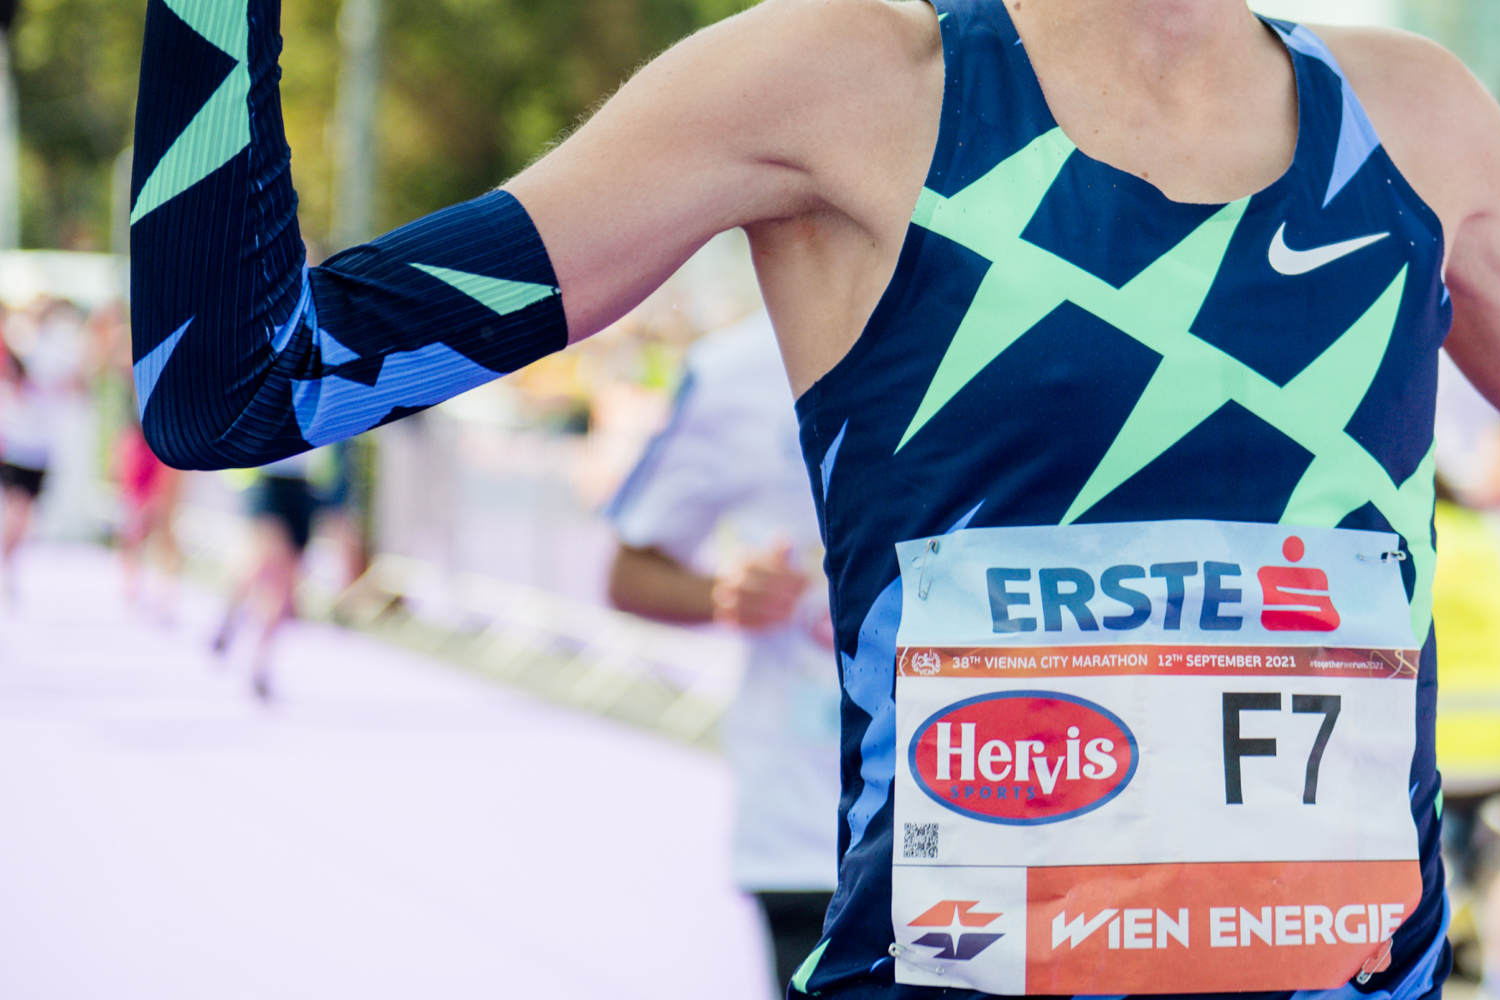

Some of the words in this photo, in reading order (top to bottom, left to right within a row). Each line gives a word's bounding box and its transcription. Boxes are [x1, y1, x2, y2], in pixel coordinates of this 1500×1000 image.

[986, 561, 1244, 634] ERSTE
[952, 655, 981, 669] 38TH
[984, 656, 1037, 669] VIENNA
[1040, 655, 1068, 669] CITY
[1072, 653, 1148, 668] MARATHON
[1157, 653, 1183, 667] 12TH
[1186, 654, 1262, 668] SEPTEMBER
[1265, 655, 1297, 668] 2021
[936, 721, 1118, 795] Hervis
[1221, 691, 1342, 805] F7
[950, 785, 1036, 800] SPORTS
[1051, 907, 1189, 950] WIEN
